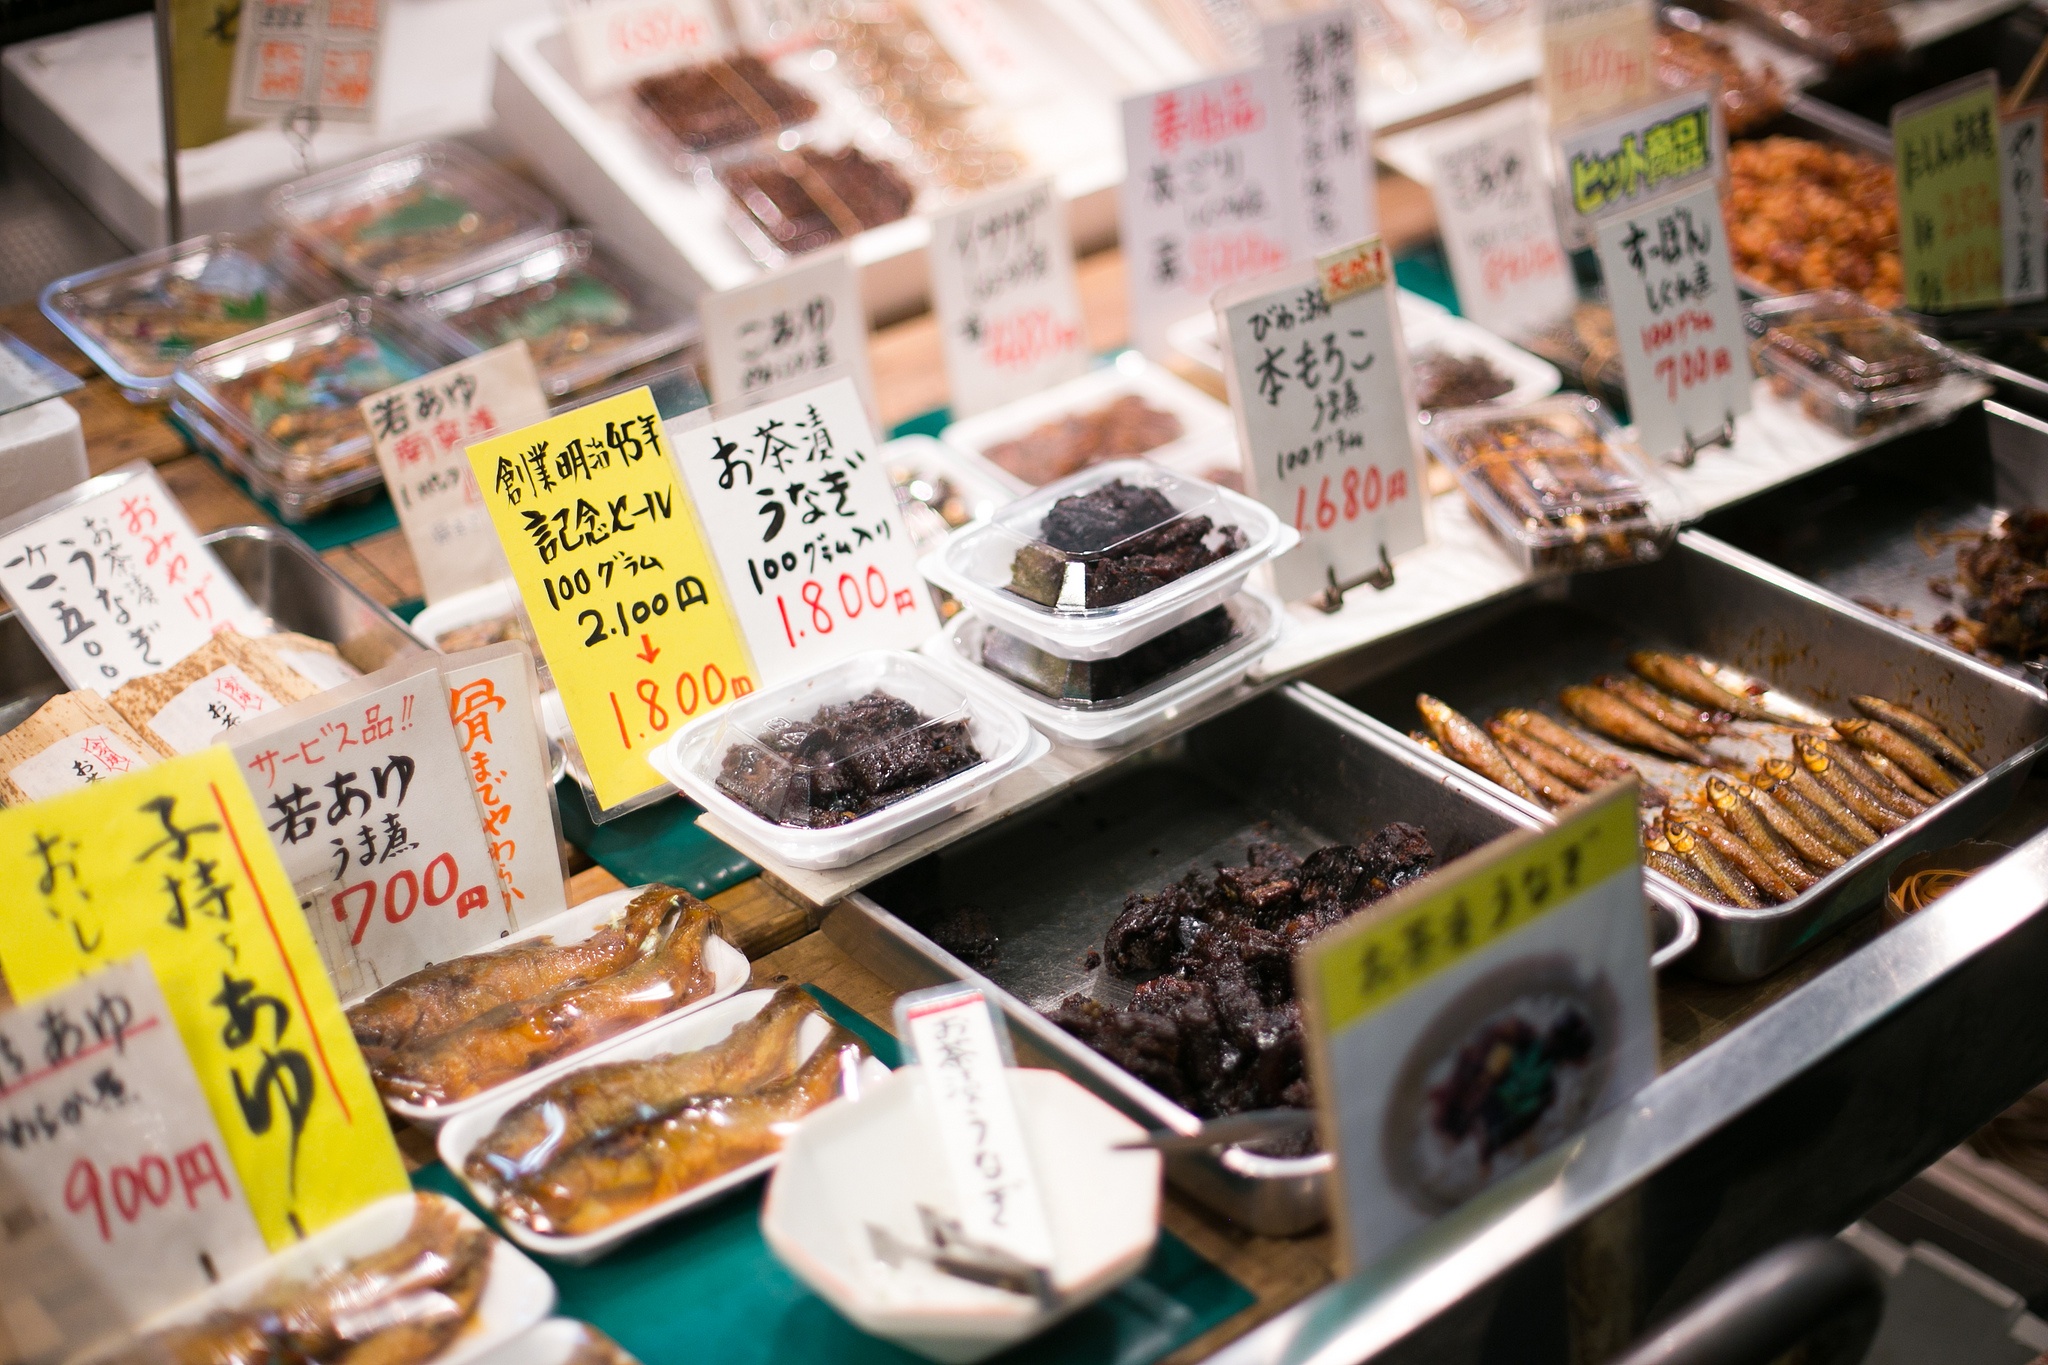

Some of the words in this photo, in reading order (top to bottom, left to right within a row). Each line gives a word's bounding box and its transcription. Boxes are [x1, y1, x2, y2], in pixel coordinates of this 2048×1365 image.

[371, 372, 477, 443] 若あゆ
[1255, 330, 1375, 406] 本もろこ
[495, 414, 662, 506] 創業明治45年
[711, 403, 833, 490] お茶漬
[756, 450, 866, 543] うなぎ
[542, 551, 665, 612] 100グラム
[747, 518, 891, 596] 100グラム入り
[58, 537, 162, 667] うなぎ
[577, 576, 709, 648] 2.100円
[776, 564, 917, 649] 1.800円
[609, 663, 754, 750] 1.800円
[267, 754, 416, 845] 若あゆ
[330, 813, 420, 881] うま煮
[29, 832, 122, 977] おいし
[330, 851, 490, 946] 700円
[62, 1140, 234, 1244] 900円
